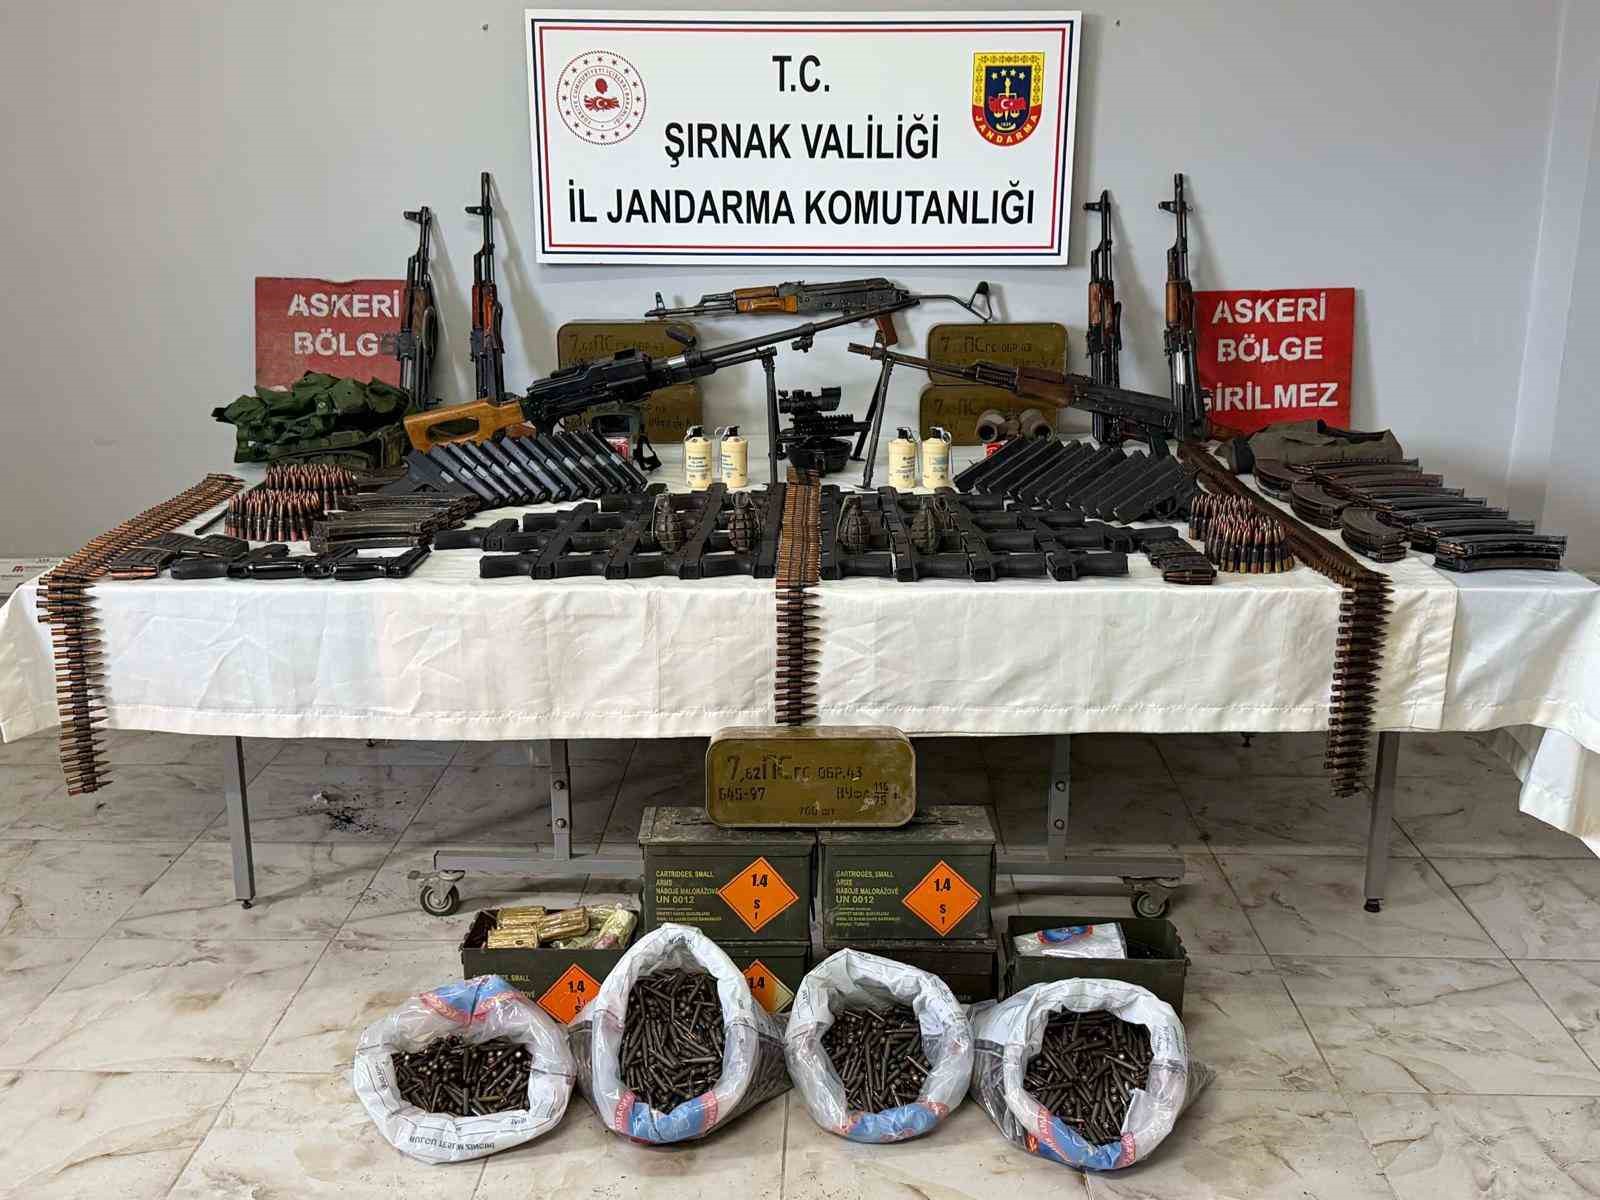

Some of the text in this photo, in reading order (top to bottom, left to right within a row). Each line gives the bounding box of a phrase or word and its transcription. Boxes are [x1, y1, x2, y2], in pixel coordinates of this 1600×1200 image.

[773, 55, 829, 92] T.C.
[664, 114, 938, 167] ŞIRNAK VALİLİĞİ
[975, 114, 1038, 144] JANDARMA
[569, 180, 1034, 224] İL JANDARMA KOMUTANLIĞI
[288, 290, 400, 318] ASKERİ
[1211, 292, 1326, 324] ASKERİ
[294, 328, 398, 357] BÖLG
[1217, 333, 1323, 363] BÖLGE
[751, 874, 768, 888] 1.4
[934, 878, 952, 892] 1.4
[656, 895, 695, 904] UN 0012
[754, 899, 760, 910] S
[835, 895, 874, 904] UN 0012
[939, 904, 946, 914] S
[568, 980, 585, 993] 1.4
